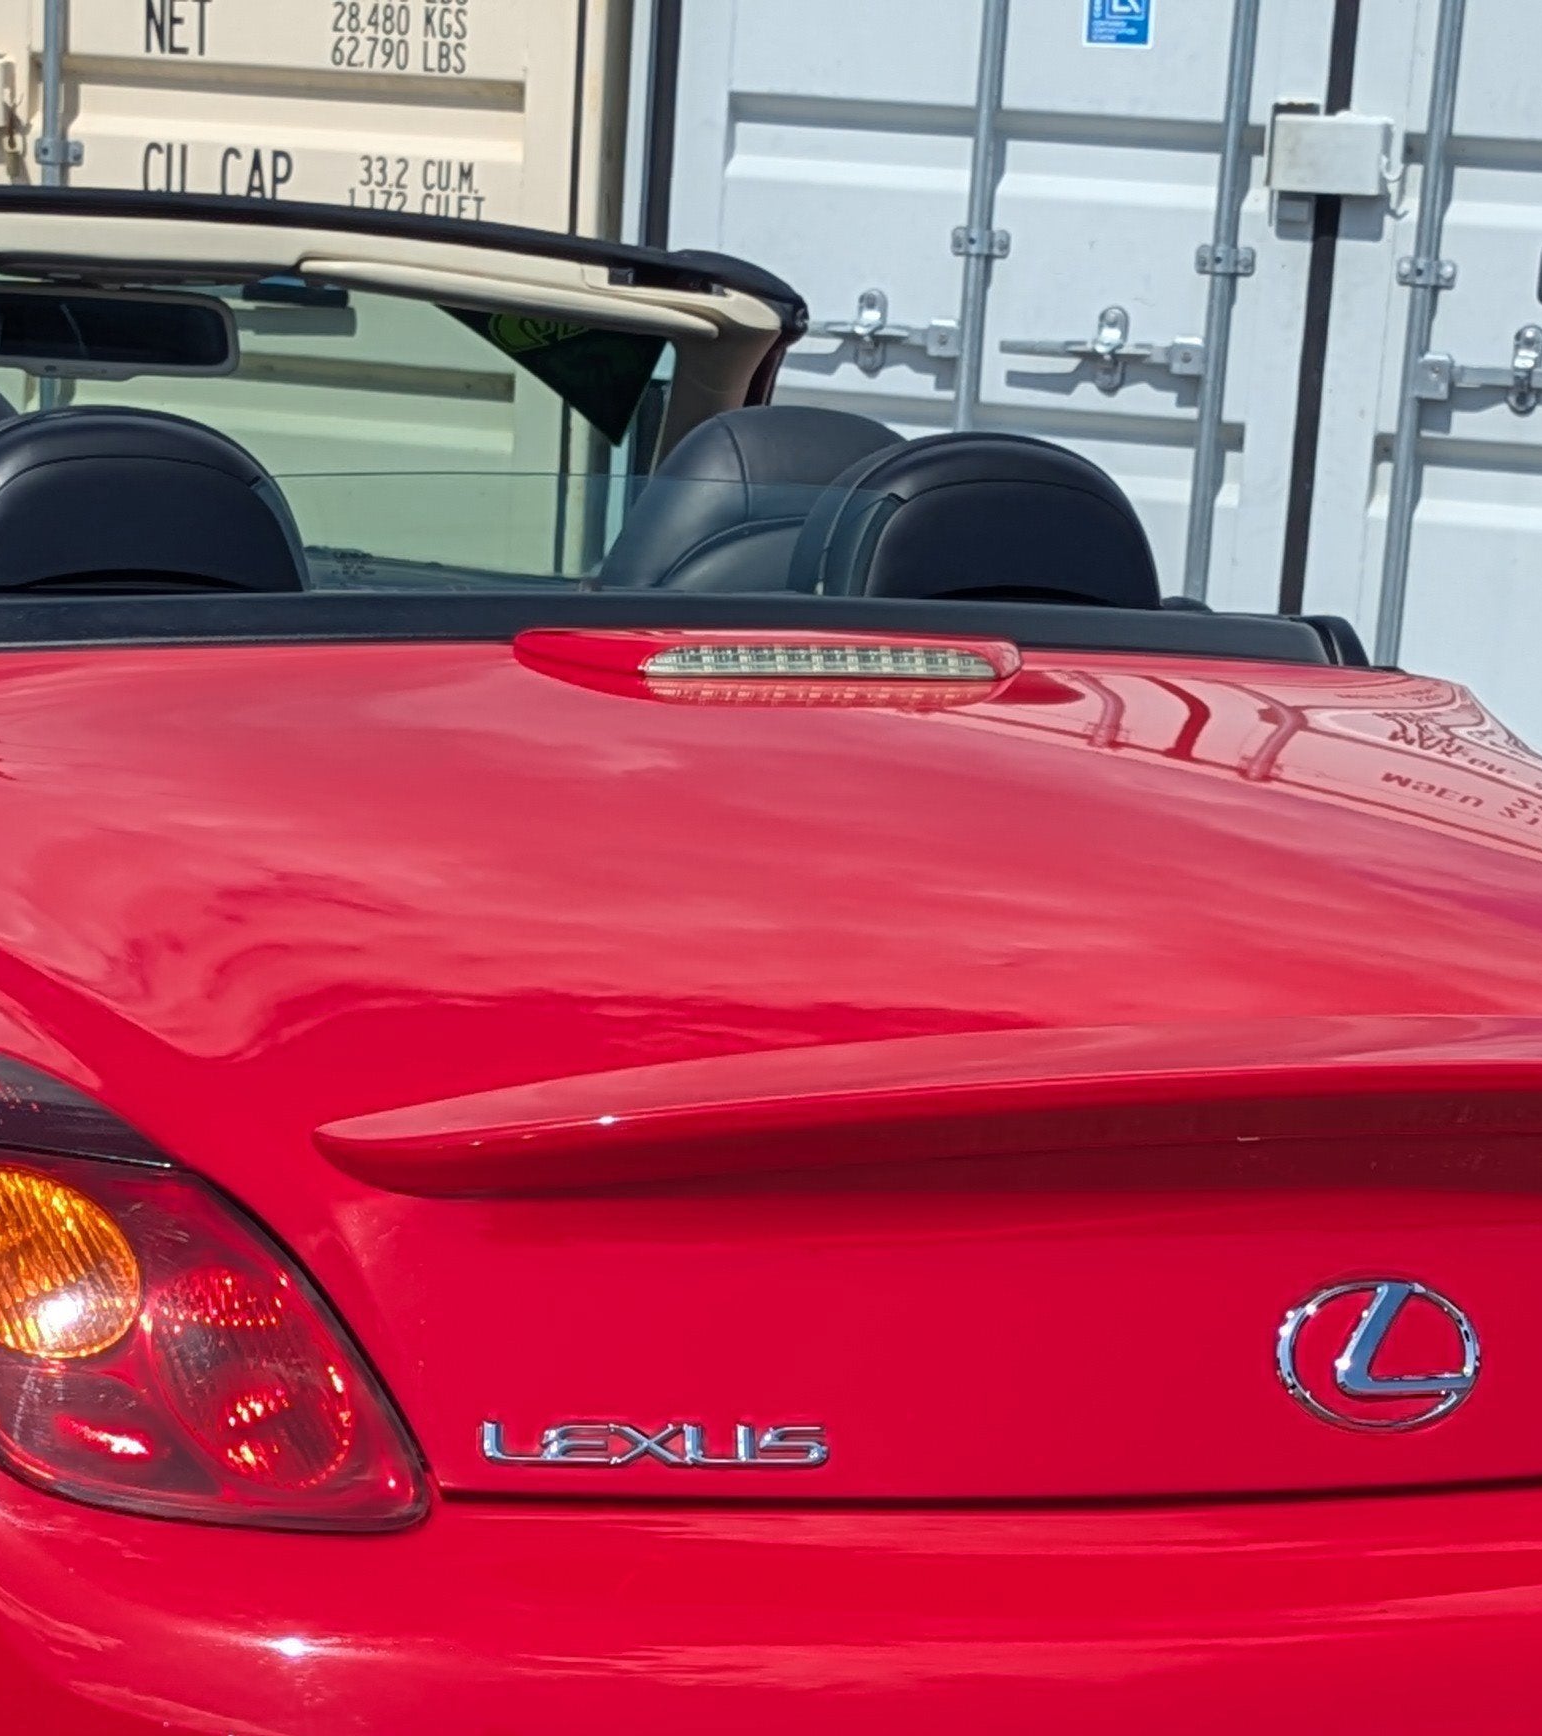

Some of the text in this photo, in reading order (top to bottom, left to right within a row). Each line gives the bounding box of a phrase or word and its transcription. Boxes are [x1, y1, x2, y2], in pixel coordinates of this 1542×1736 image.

[144, 0, 211, 56] NET
[423, 6, 467, 39] KGS
[423, 41, 466, 74] LBS
[359, 155, 408, 189] 33.2
[477, 1419, 829, 1468] LEXUS
